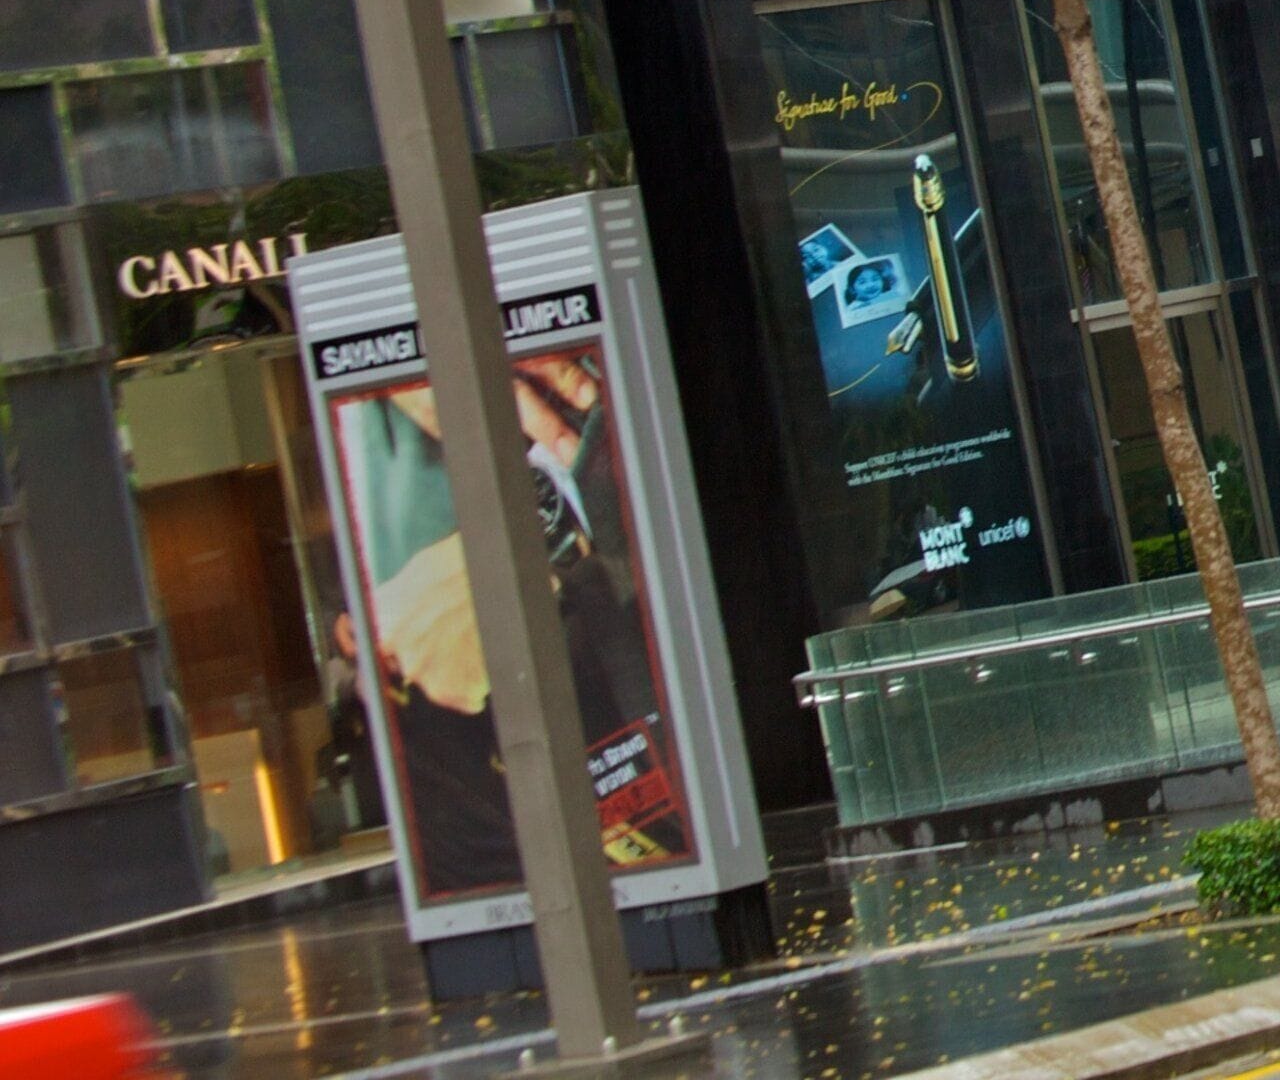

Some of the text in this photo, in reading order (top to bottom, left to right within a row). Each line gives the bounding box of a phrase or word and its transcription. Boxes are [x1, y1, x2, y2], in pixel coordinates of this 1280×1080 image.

[776, 82, 899, 131] Signature for Good
[119, 233, 308, 298] CANALI
[320, 330, 417, 374] SAYANGI
[920, 522, 963, 551] MONT
[978, 518, 1016, 547] unicef
[924, 542, 970, 572] BLANC
